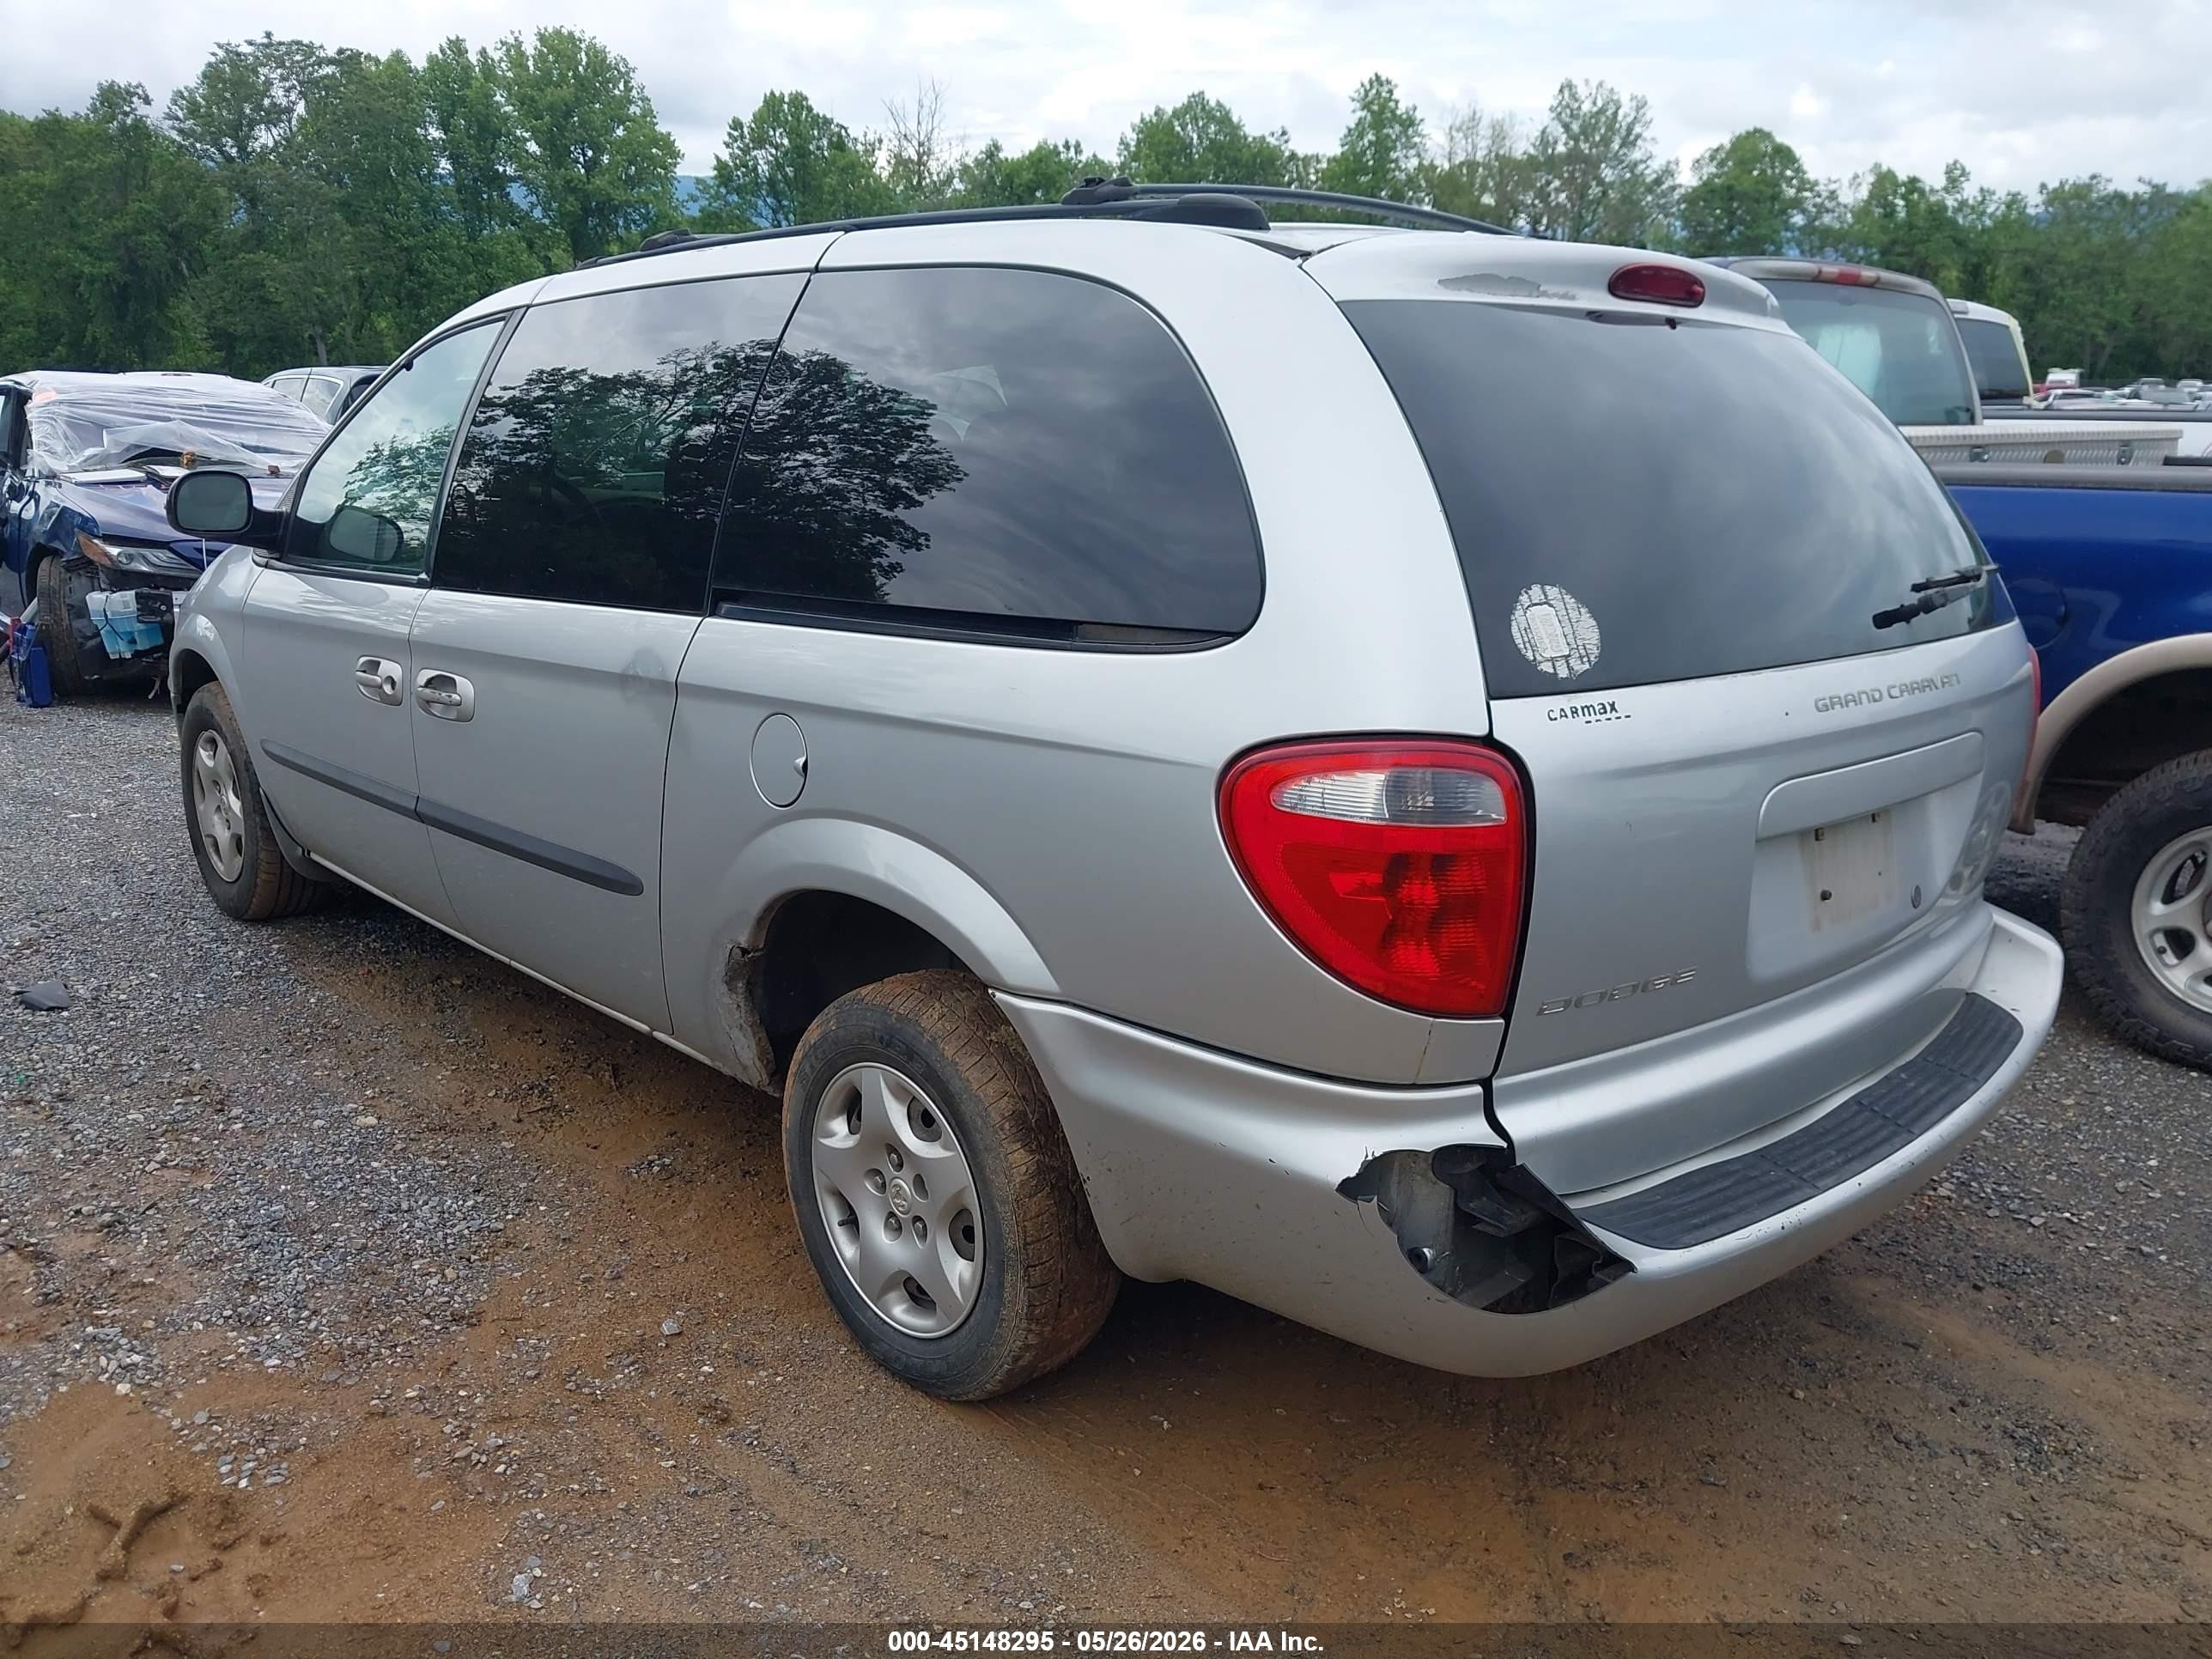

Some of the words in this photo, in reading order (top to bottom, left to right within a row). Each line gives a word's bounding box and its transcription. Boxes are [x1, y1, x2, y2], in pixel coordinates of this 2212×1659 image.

[1814, 689, 1883, 714] GRAND
[1887, 673, 1961, 700] CARAVAN
[1536, 966, 1698, 1017] DODGE
